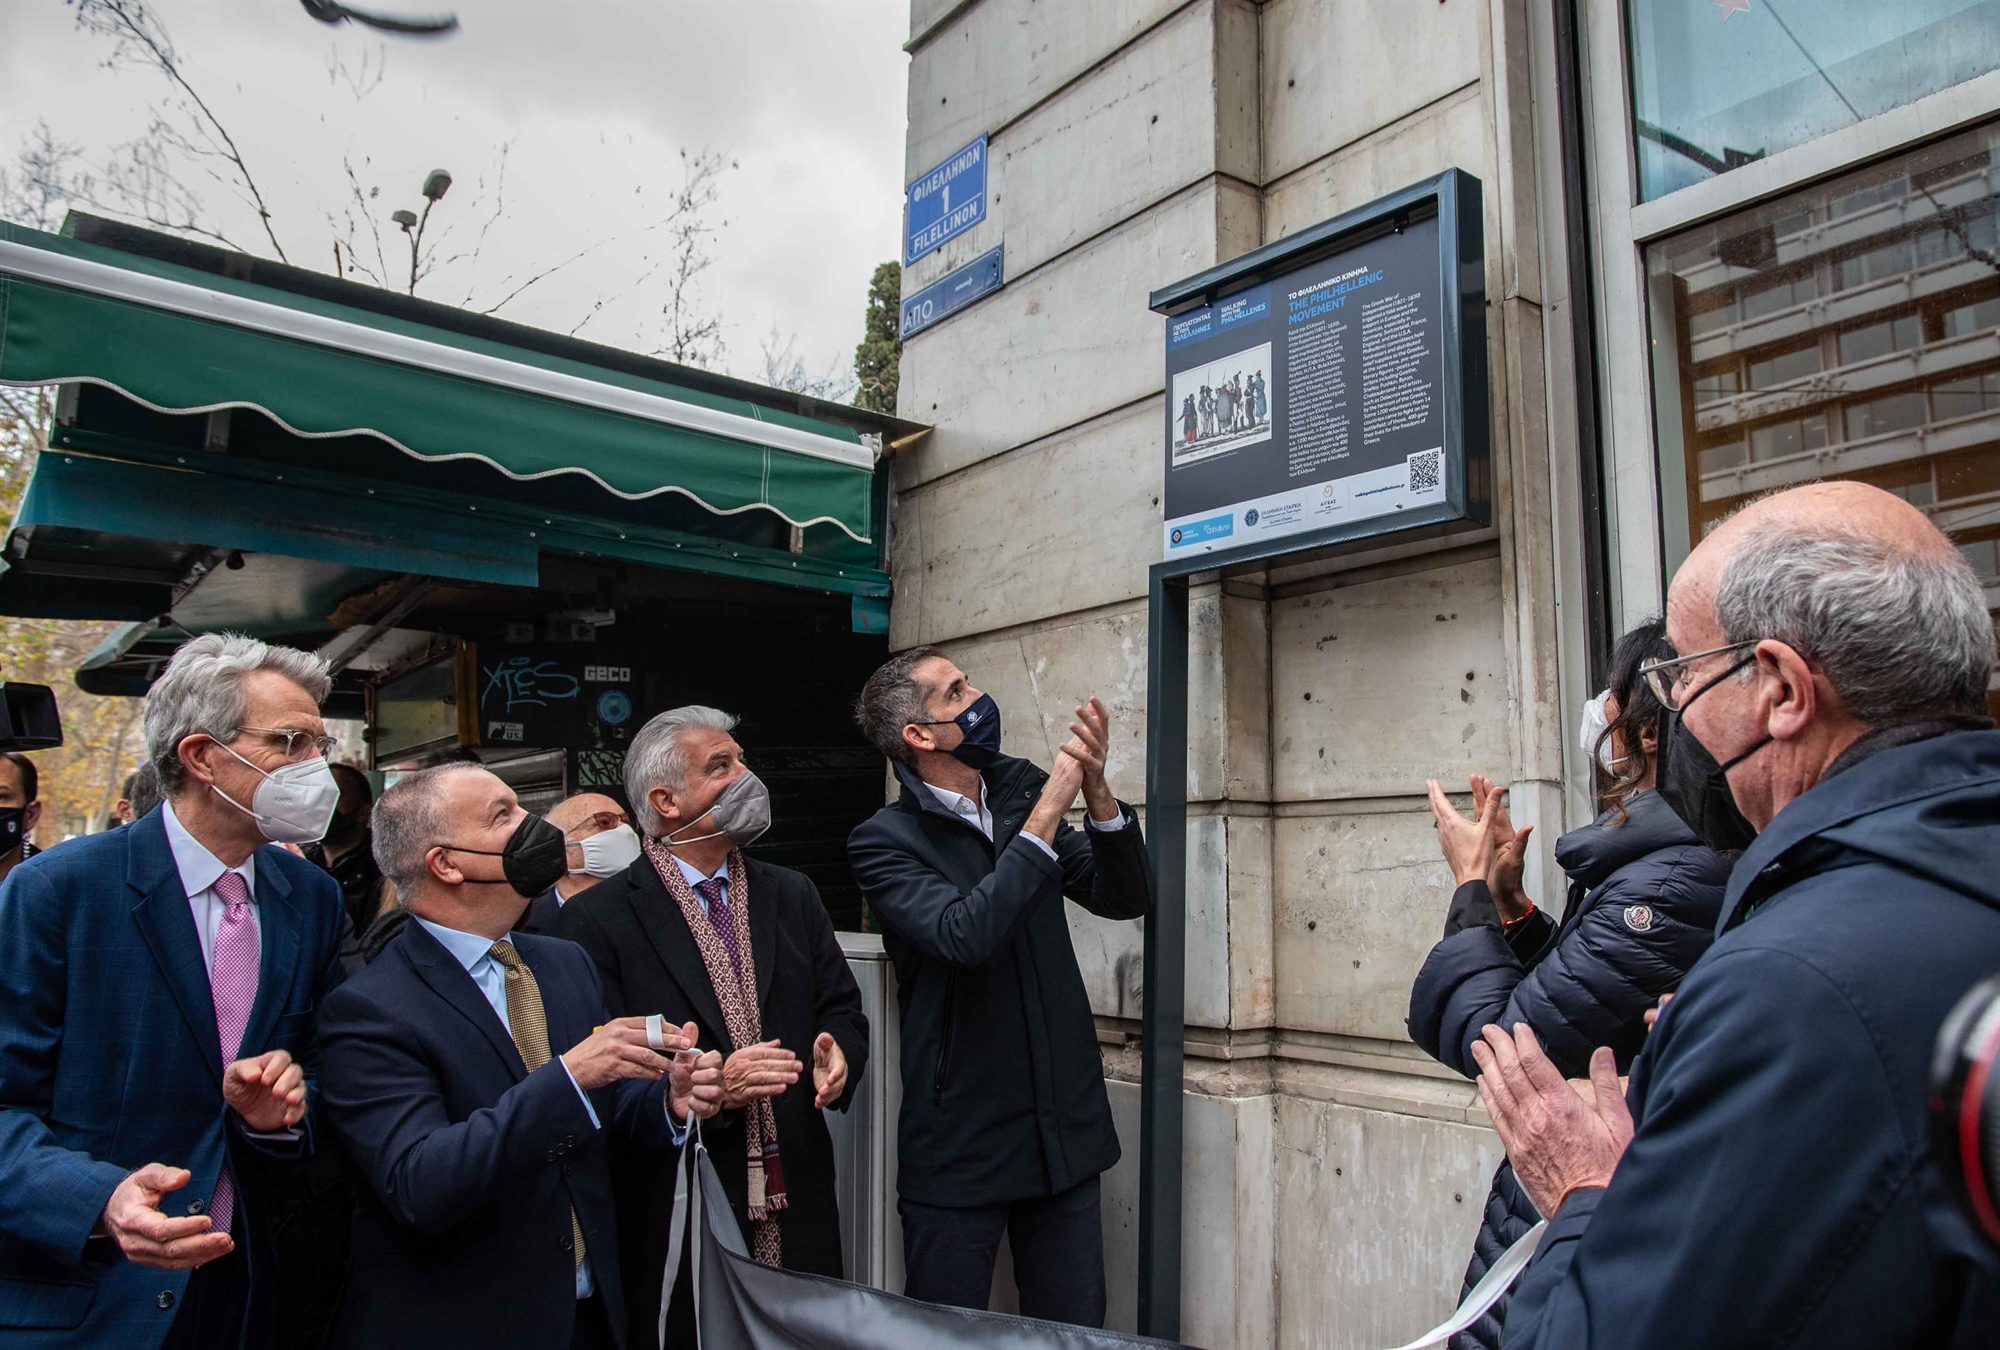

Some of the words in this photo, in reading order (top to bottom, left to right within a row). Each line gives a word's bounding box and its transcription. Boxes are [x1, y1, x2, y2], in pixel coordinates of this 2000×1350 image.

[914, 145, 980, 202] ΦΙΛΕΛΛΗΝΩΝ
[941, 185, 950, 214] 1
[914, 201, 977, 253] FILELLINON
[1288, 292, 1297, 300] ΤΟ
[1298, 276, 1340, 296] ΦΙΛΕΛΛΗΝΙΚΟ
[1342, 267, 1368, 280] ΚΙΝΗΜΑ
[1289, 297, 1308, 311] THE
[1311, 270, 1383, 303] PHILHELLENIC
[1221, 299, 1246, 313] WALKING
[1362, 303, 1392, 316] Independence
[1371, 299, 1384, 307] Greek
[1221, 303, 1265, 324] PHILHELLENES
[1289, 297, 1345, 324] MOVEMENT
[1362, 312, 1382, 323] triggered
[1363, 320, 1379, 329] support
[1385, 314, 1400, 322] Europe
[1384, 318, 1405, 328] especially
[1363, 344, 1386, 354] Philhellenic
[1387, 335, 1413, 346] committees
[1363, 350, 1386, 360] fundraisers
[1396, 339, 1421, 350] distributed
[1375, 355, 1392, 364] supplies
[1379, 373, 1398, 382] including
[1380, 392, 1400, 401] Delacroix
[1413, 383, 1431, 392] inspired
[1377, 400, 1395, 408] heroism
[1389, 402, 1412, 412] volunteers
[1364, 417, 1384, 425] countries
[1401, 420, 1420, 428] freedom
